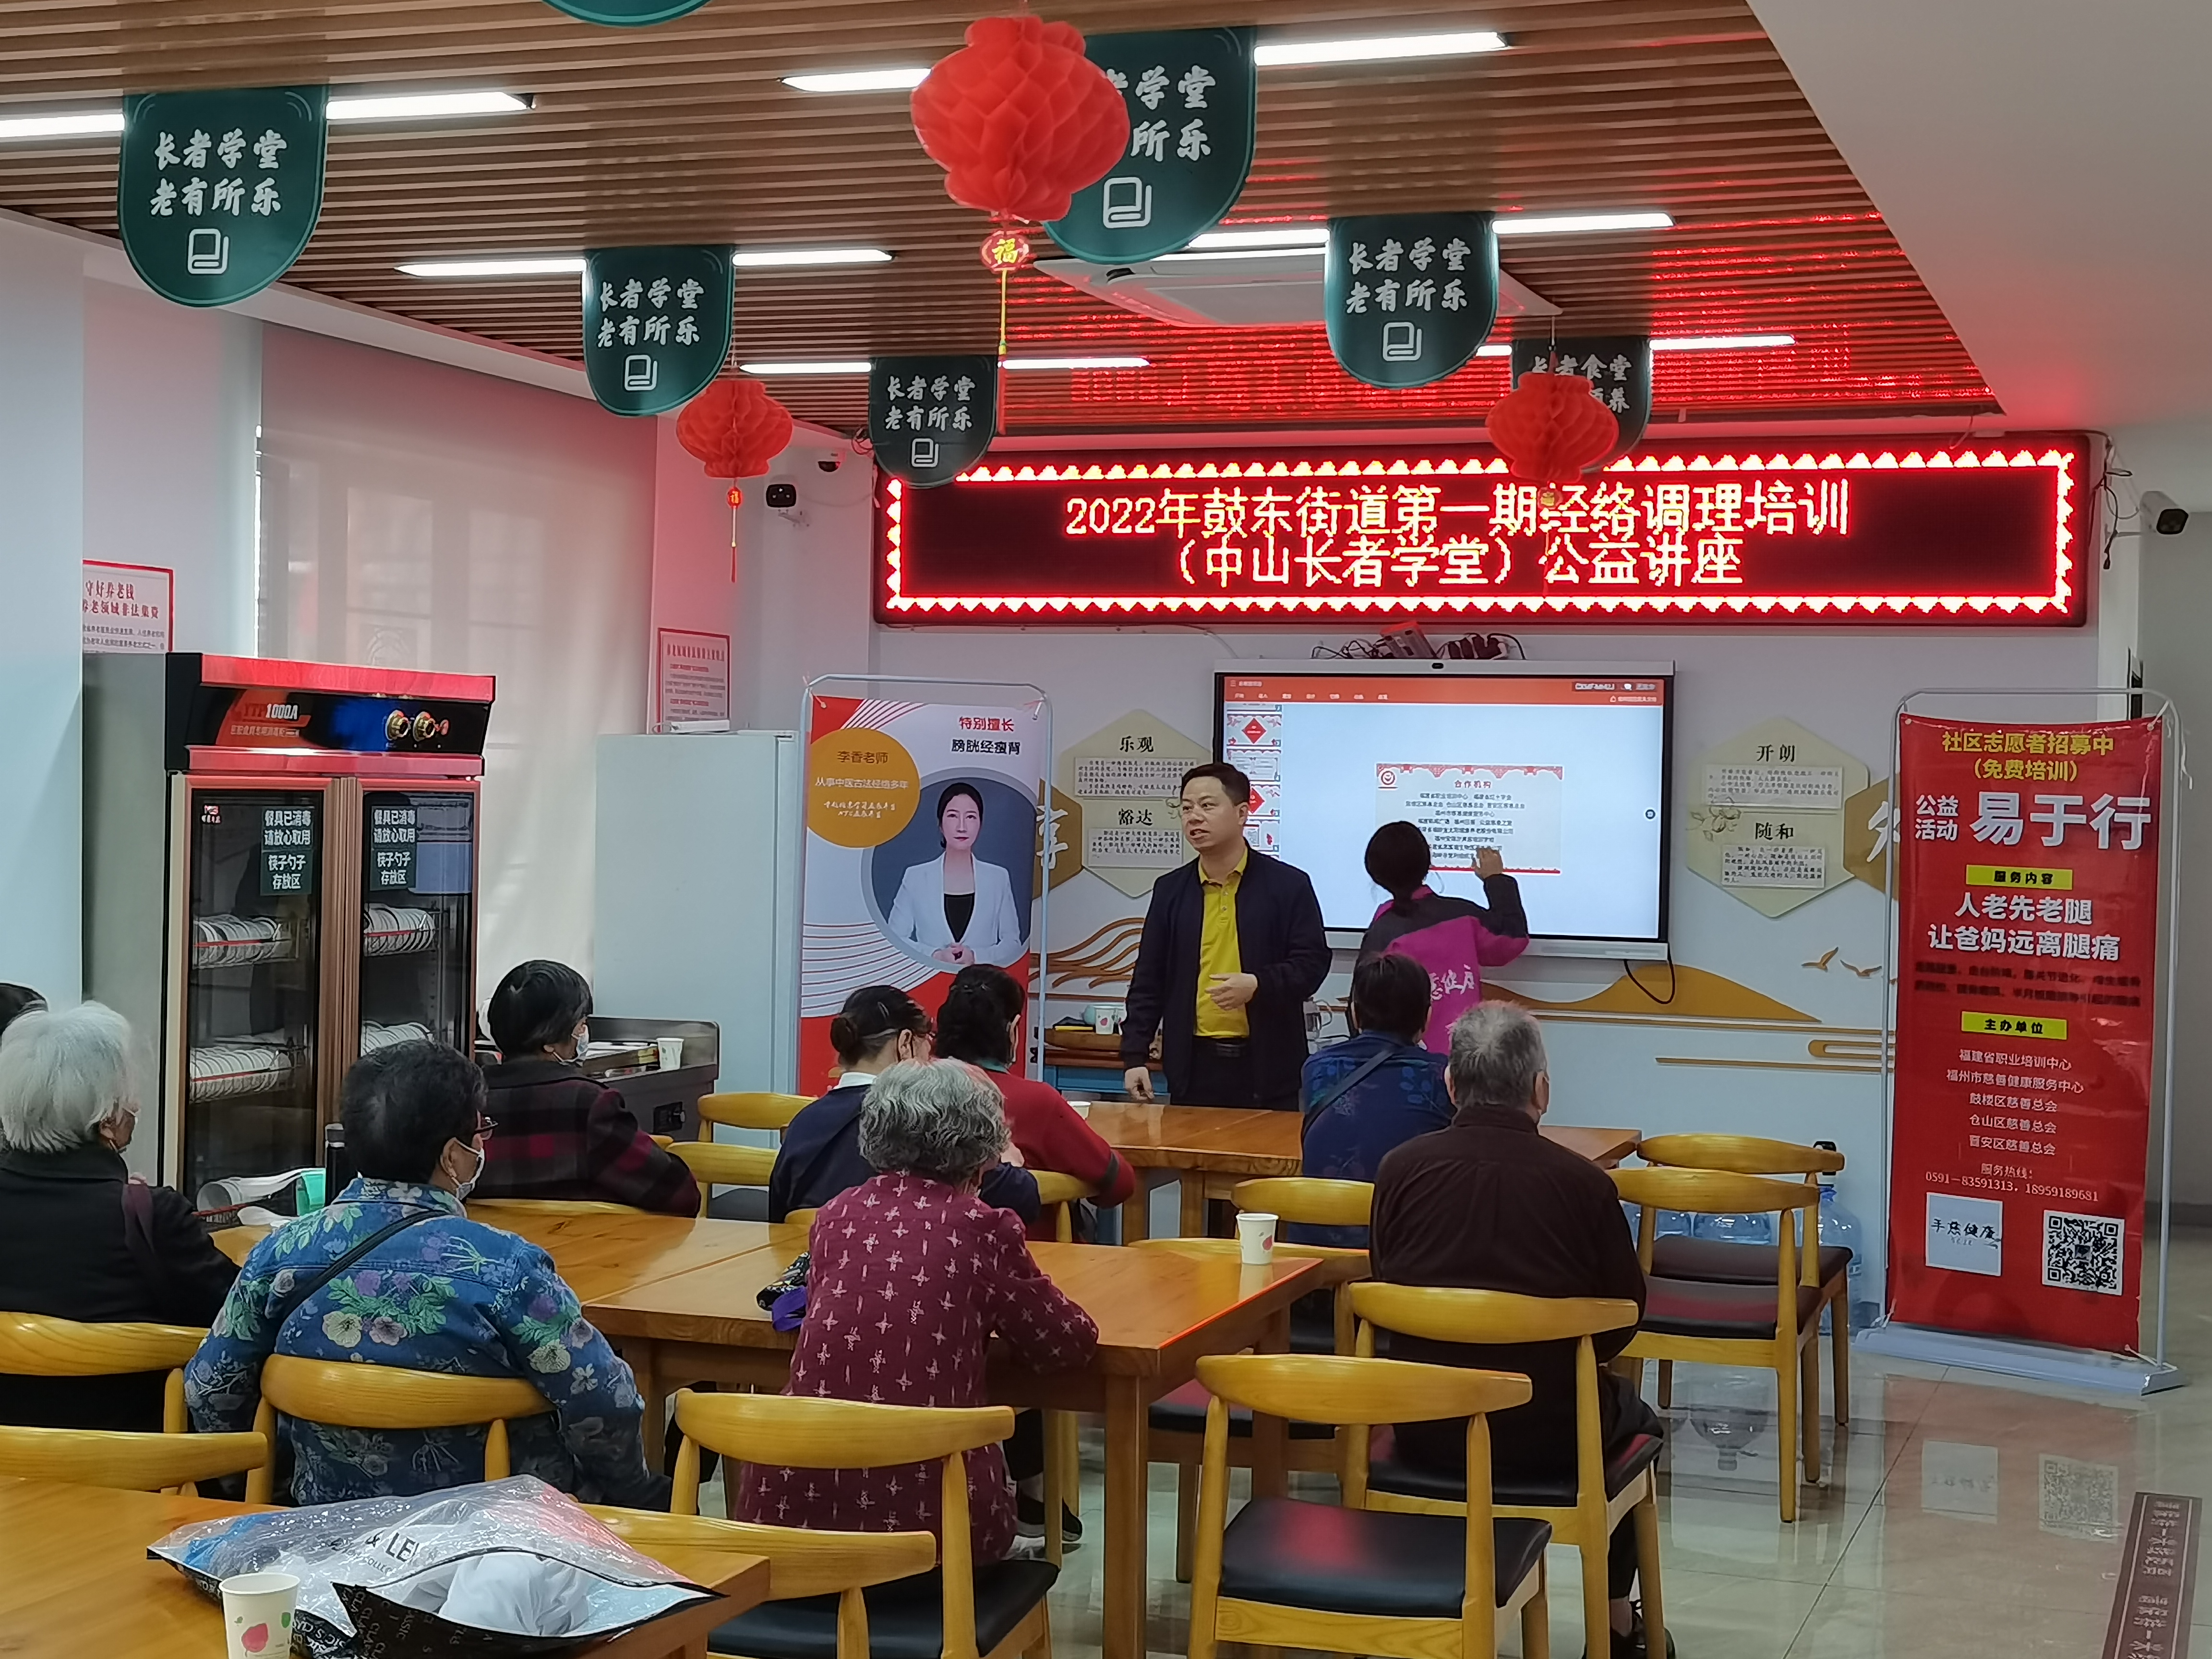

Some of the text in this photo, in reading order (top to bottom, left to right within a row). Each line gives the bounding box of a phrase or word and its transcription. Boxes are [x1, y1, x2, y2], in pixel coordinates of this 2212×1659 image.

[154, 128, 288, 170] 长者学堂
[150, 177, 282, 217] 老有所乐
[992, 238, 1019, 264] 福
[1348, 237, 1472, 275] 长者学堂
[600, 277, 705, 313] 长者学堂
[1346, 278, 1468, 314] 老有所乐
[597, 314, 701, 348] 老有所乐
[886, 375, 977, 402] 长者学堂
[884, 405, 974, 432] 老有所乐
[1065, 478, 1850, 540] 2022年鼓东街道第一期经络调理培训
[959, 716, 1015, 732] 特别擅长
[1119, 735, 1154, 753] 乐观
[1755, 744, 1795, 763] 开朗
[1941, 730, 2115, 756] 社区志愿者招募中
[1118, 807, 1153, 826] 豁达
[1915, 794, 1959, 817] 公益
[1755, 822, 1794, 841] 随和
[1915, 818, 1958, 842] 活动
[1970, 791, 2152, 850] 易于行
[1993, 870, 2054, 885] 服务内容
[1954, 891, 2093, 926] 人老先老腿
[1927, 923, 2121, 962] 让爸妈远离腿痛
[1984, 1018, 2044, 1035] 主办单位
[1959, 1048, 2072, 1071] 福建省职业培训中心
[1946, 1069, 2084, 1094] 福州市慈善健康服务中心
[1969, 1092, 2058, 1113] 鼓楼区慈善总会
[1969, 1113, 2057, 1134] 仓山区慈善总会
